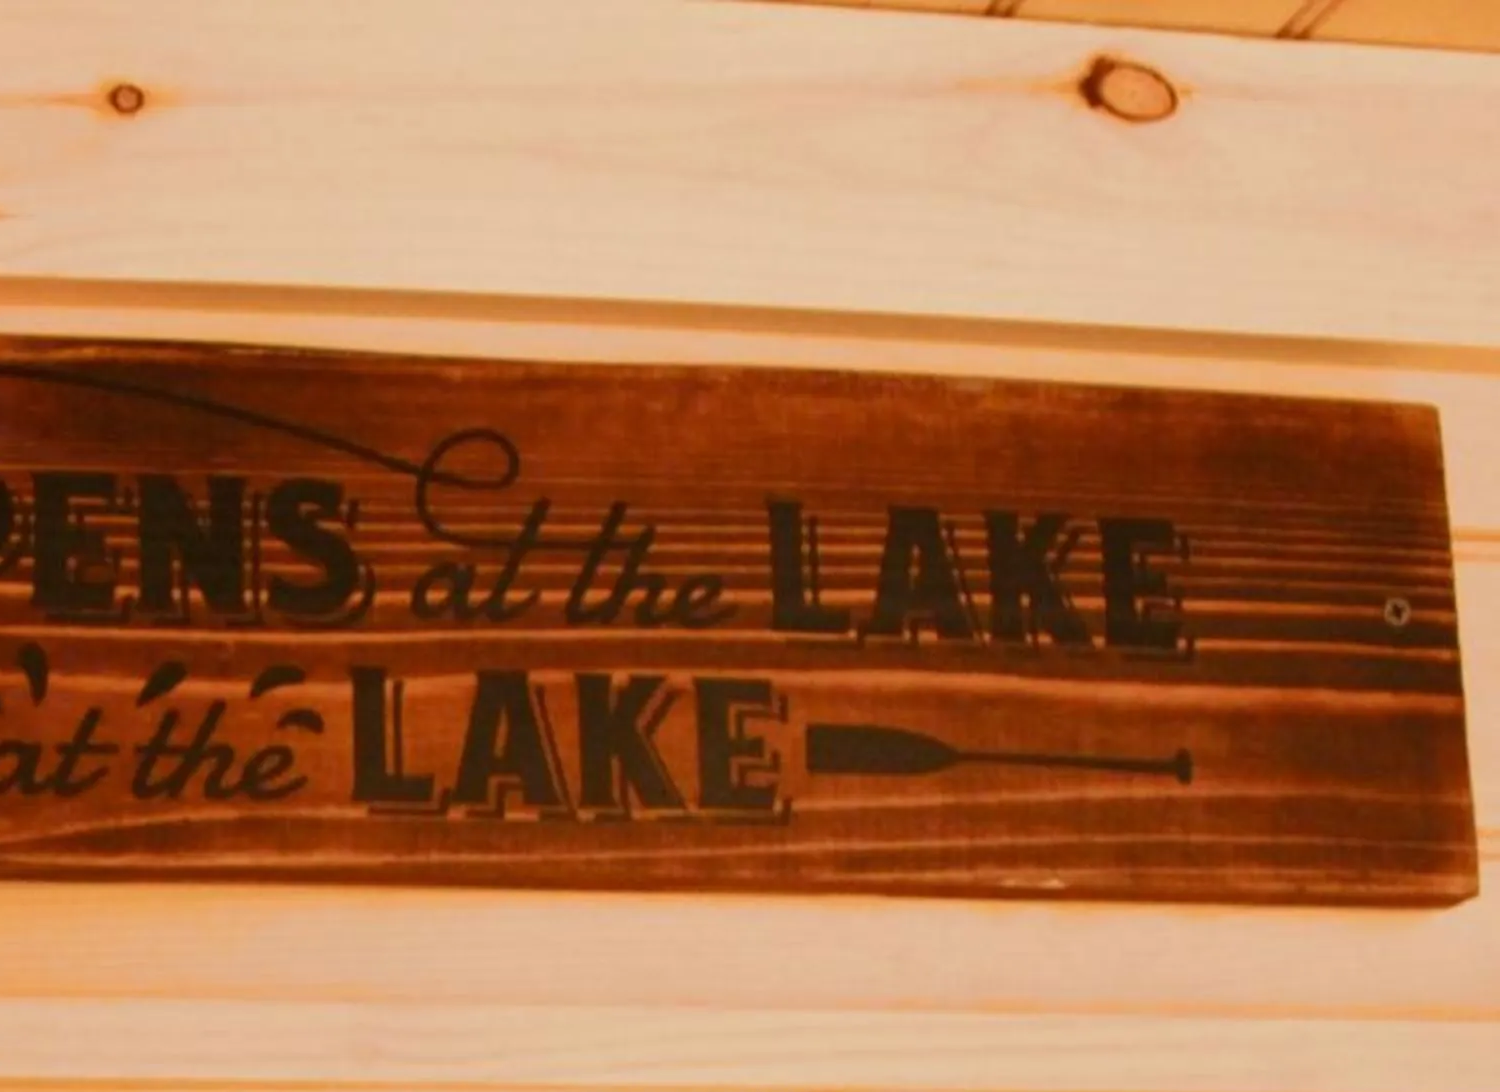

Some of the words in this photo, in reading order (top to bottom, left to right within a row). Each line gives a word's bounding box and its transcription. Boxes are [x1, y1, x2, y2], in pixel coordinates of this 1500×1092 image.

[410, 497, 551, 625] at
[563, 501, 738, 630] the
[765, 496, 1195, 662] LAKE
[132, 700, 310, 800] the
[349, 666, 793, 826] LAKE
